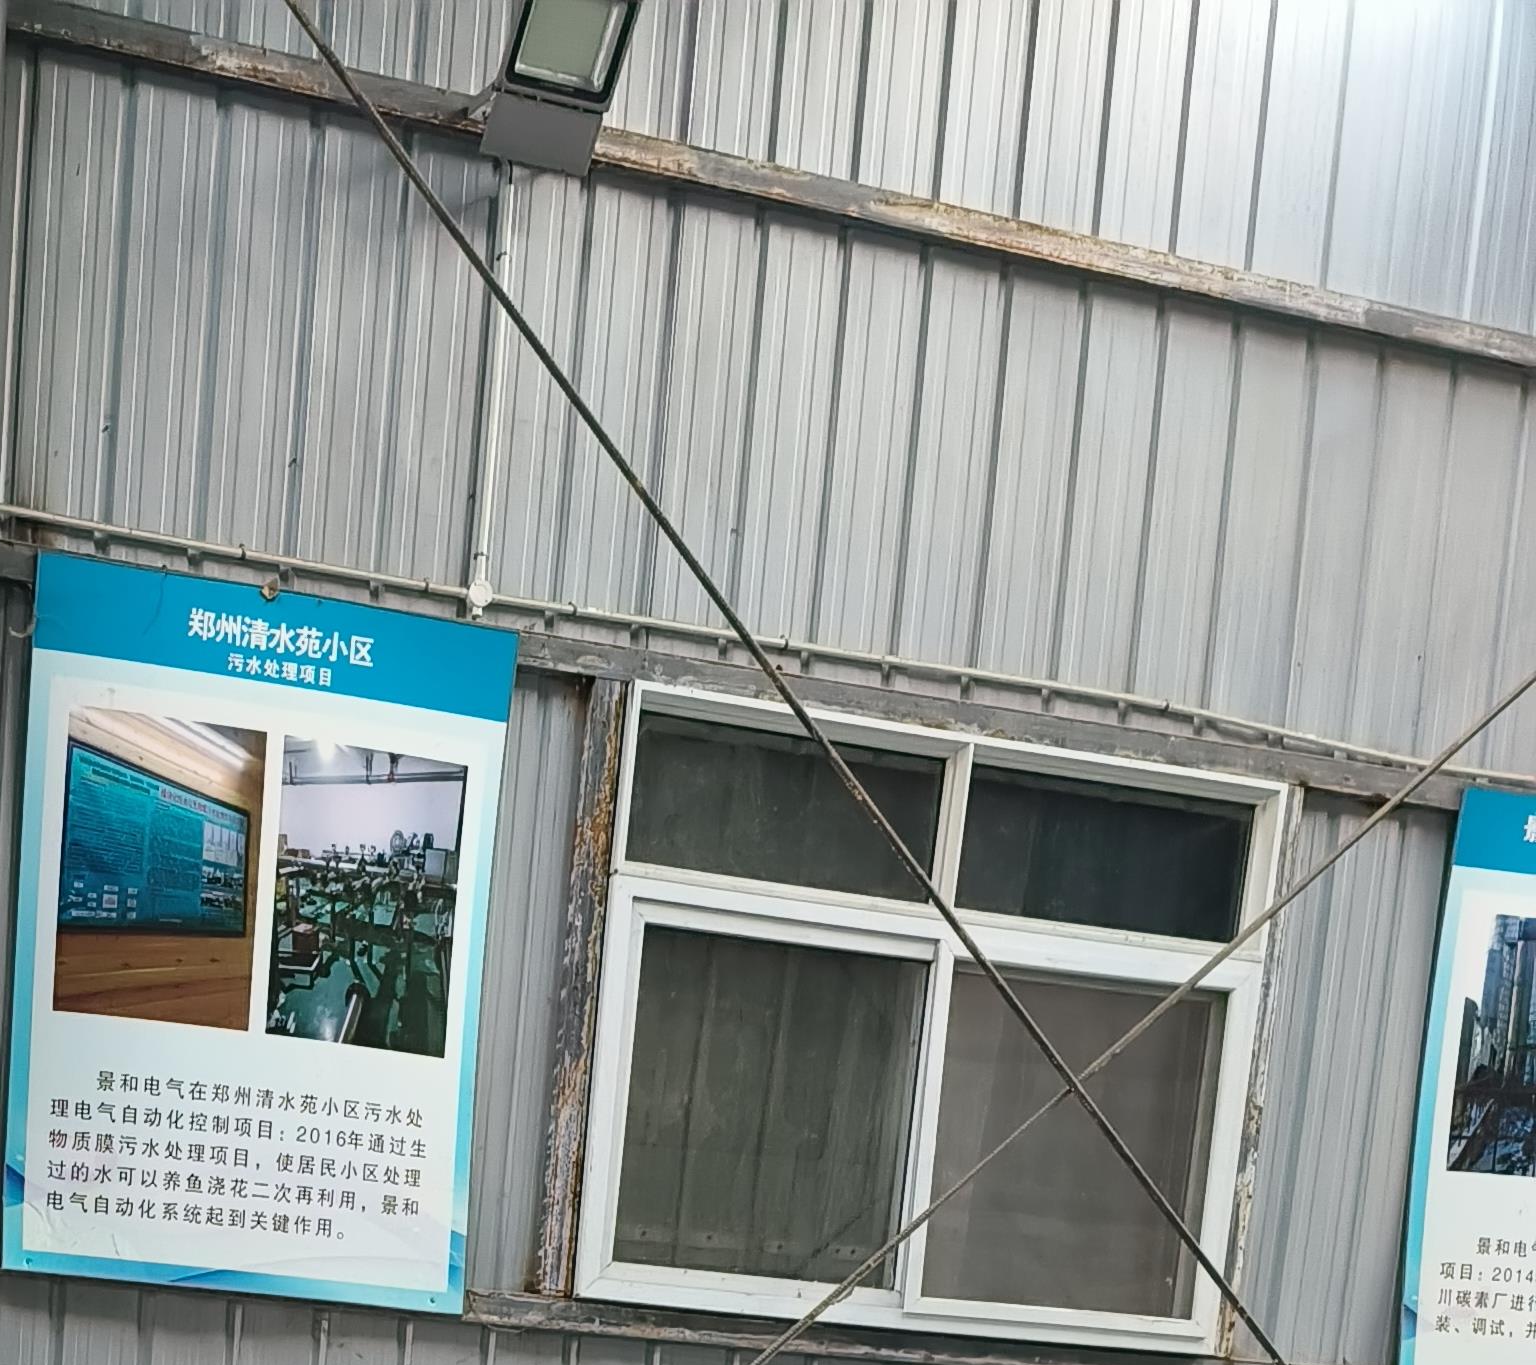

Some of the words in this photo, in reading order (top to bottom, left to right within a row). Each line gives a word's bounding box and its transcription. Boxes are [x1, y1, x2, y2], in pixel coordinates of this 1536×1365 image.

[187, 607, 375, 668] 郑州清水苑小区
[227, 652, 332, 687] 污水处理项目
[96, 1070, 424, 1128] 景和电气在郑州清水苑小区污水处
[48, 1128, 422, 1188] 物质膜污水处理项目，使居民小区处理
[46, 1191, 349, 1241] 电气自动化系统起到关键作用。
[47, 1160, 420, 1216] 过的水可以养鱼浇花二次再利用，景和
